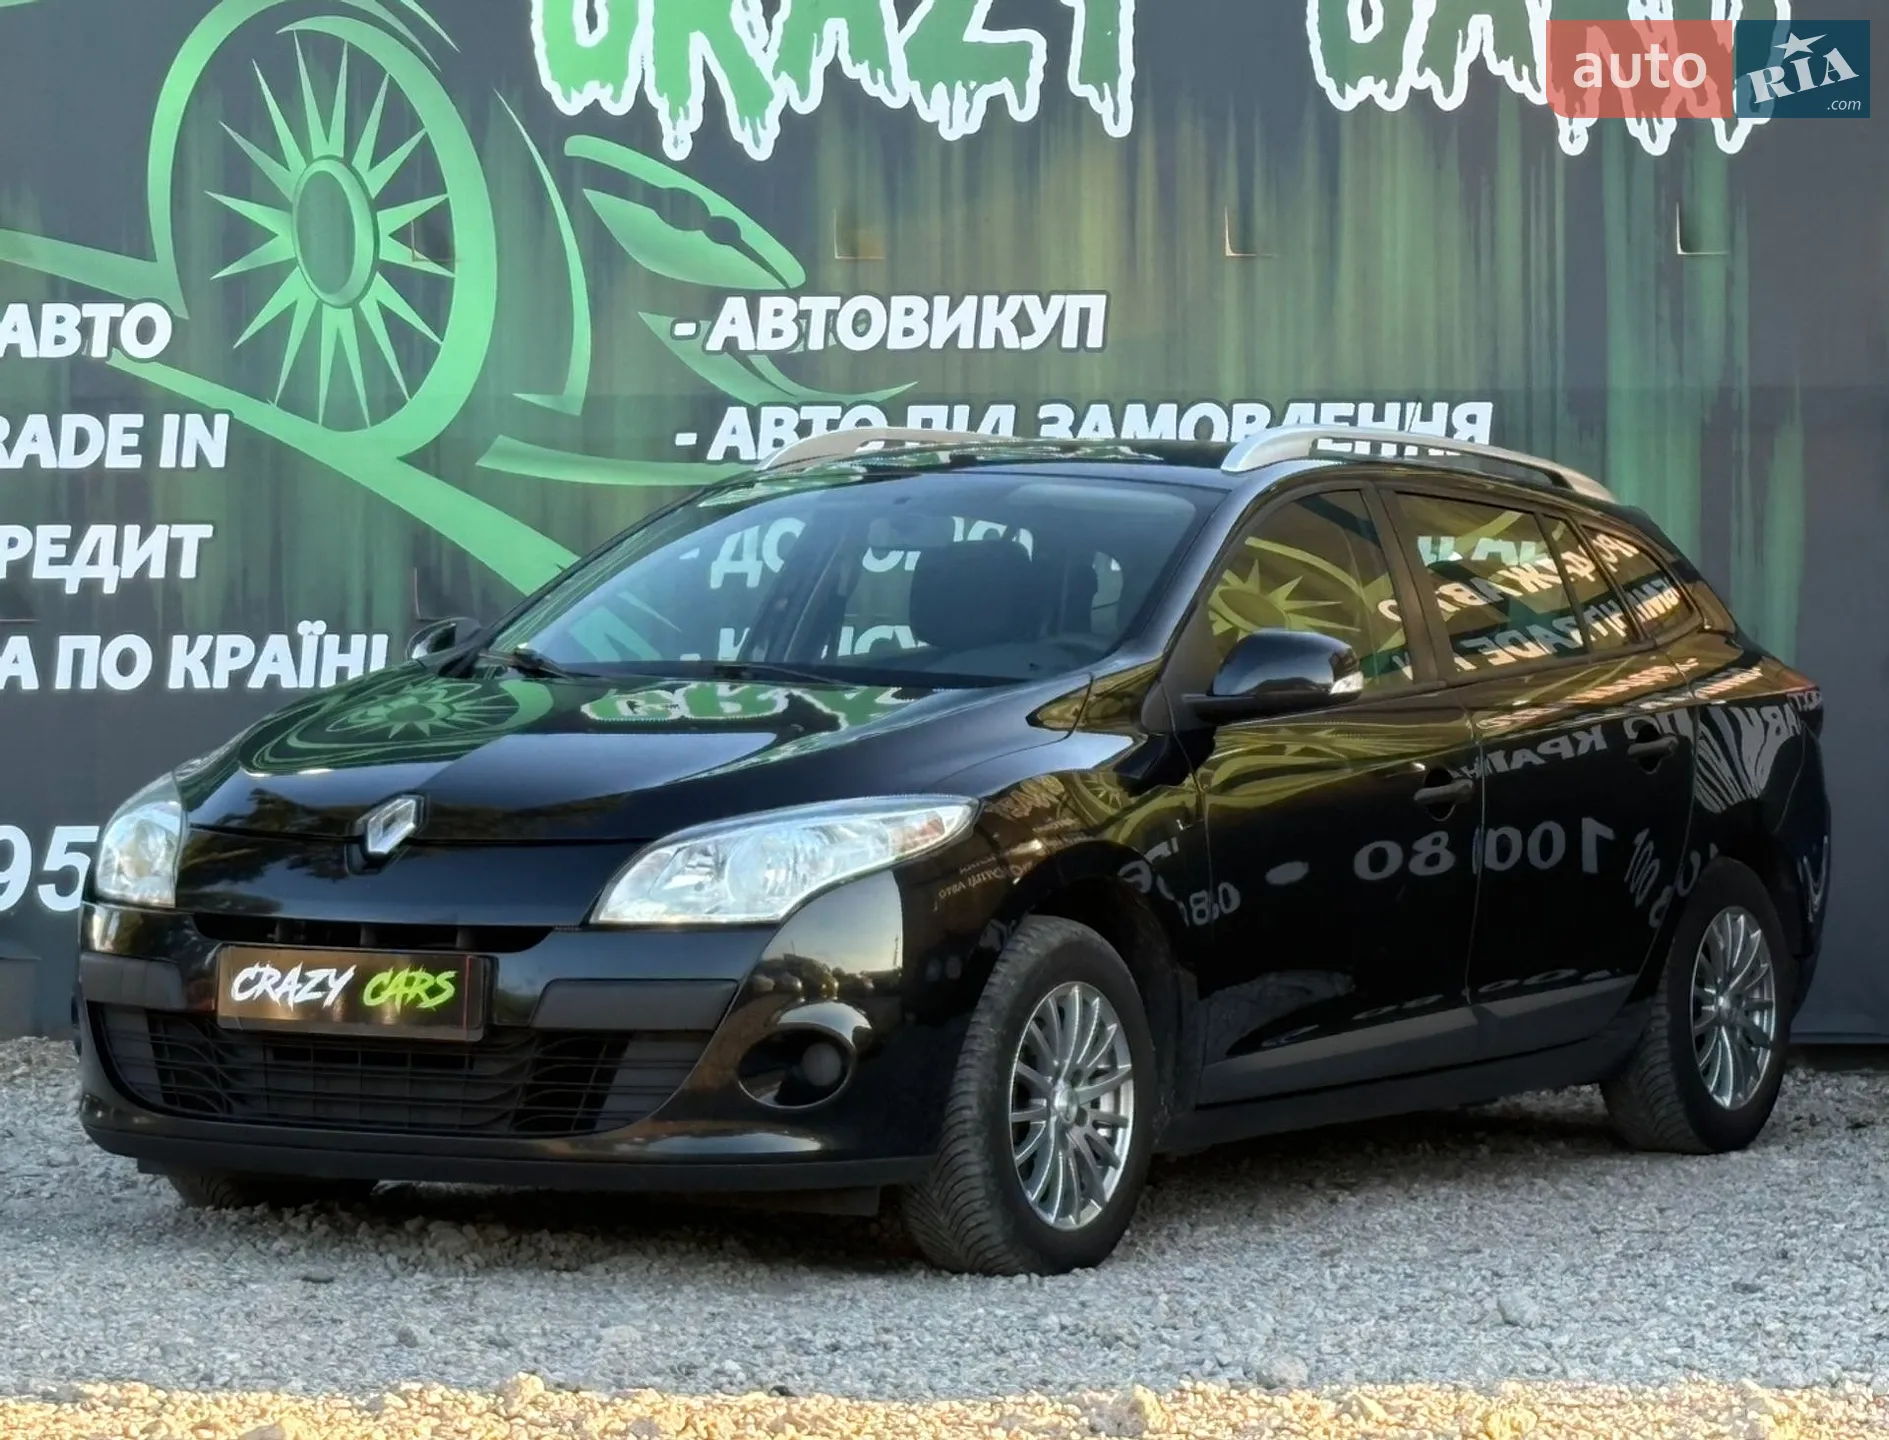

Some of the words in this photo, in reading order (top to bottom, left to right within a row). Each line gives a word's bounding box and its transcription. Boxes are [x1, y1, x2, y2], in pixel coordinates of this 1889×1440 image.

[706, 294, 1107, 351] АВТОВИКУП
[159, 413, 230, 469] IN
[55, 633, 153, 691] ПО
[168, 619, 389, 689] КРАЇНІ
[230, 960, 357, 1012] CRAZY
[362, 963, 459, 1015] CARS
